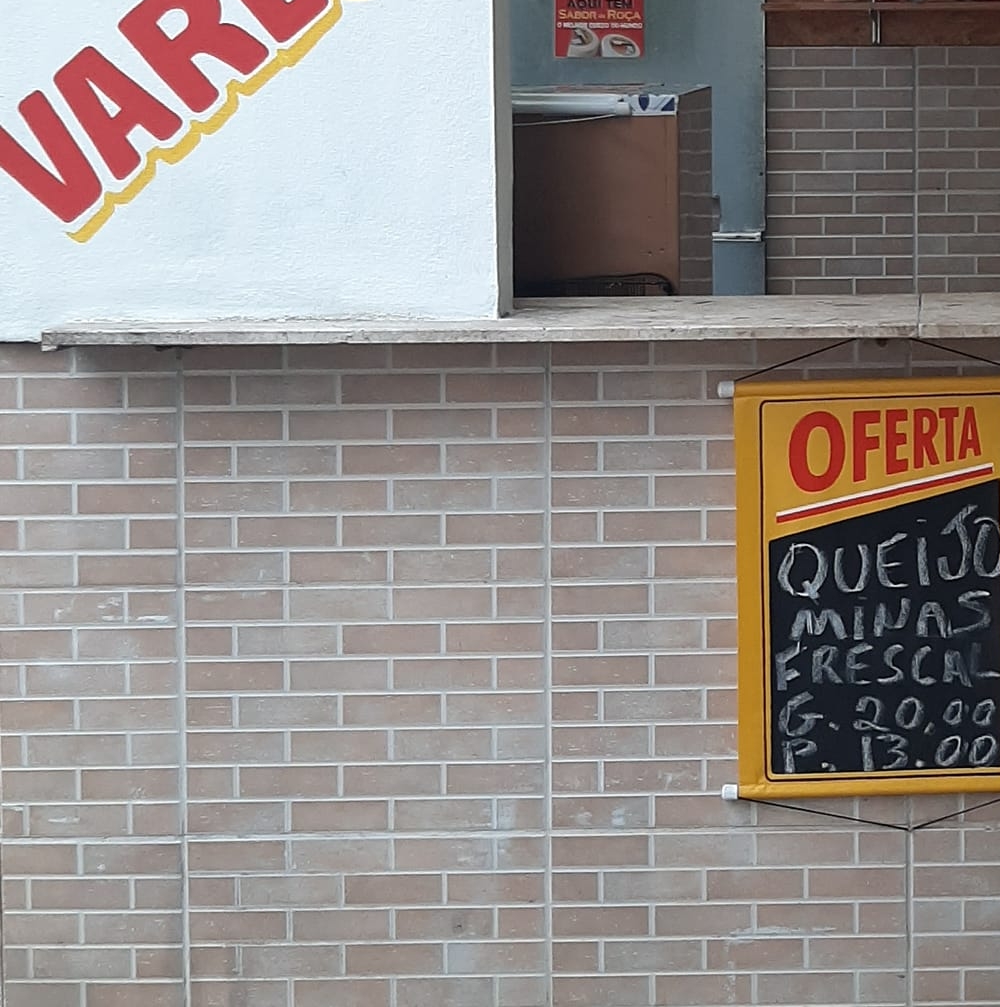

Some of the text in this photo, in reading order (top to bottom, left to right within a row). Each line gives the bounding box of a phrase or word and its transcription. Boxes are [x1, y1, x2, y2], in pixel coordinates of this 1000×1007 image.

[559, 9, 597, 20] SABOR
[607, 9, 642, 22] ROÇA
[787, 406, 982, 493] OFERTA
